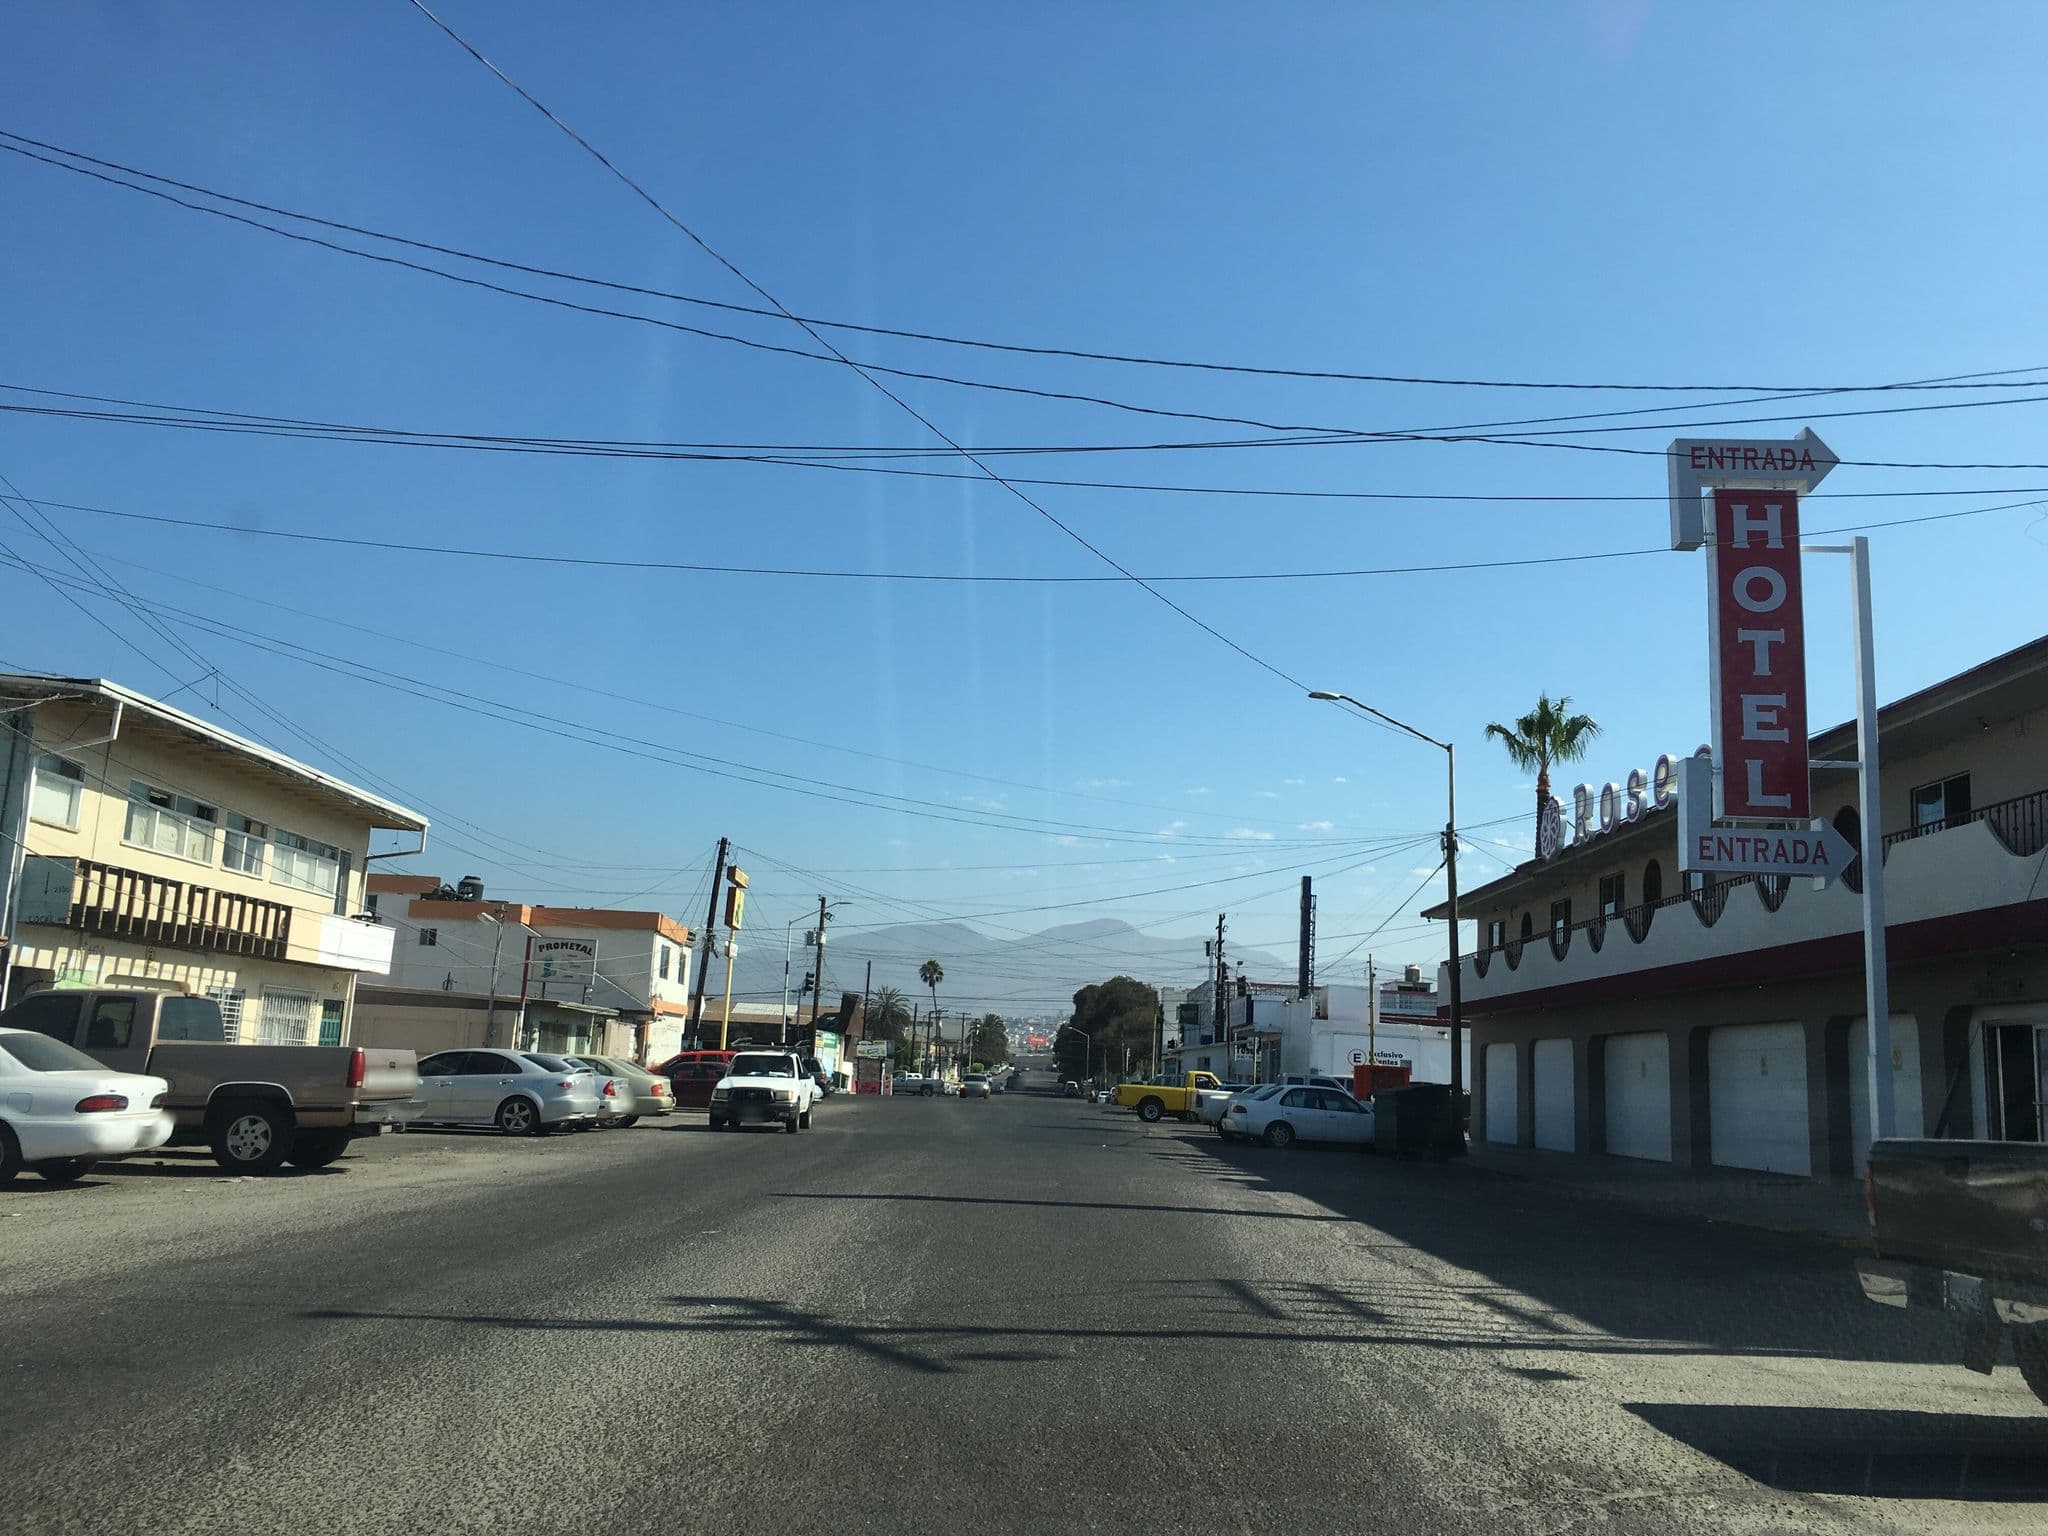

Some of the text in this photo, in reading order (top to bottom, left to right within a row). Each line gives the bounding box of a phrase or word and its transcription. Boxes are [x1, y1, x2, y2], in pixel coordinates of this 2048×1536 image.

[1690, 446, 1817, 472] ENTRADA
[1730, 504, 1792, 809] HOTEL
[1698, 835, 1829, 865] ENTRADA
[538, 941, 593, 956] PROMETAL
[1353, 1053, 1362, 1063] E
